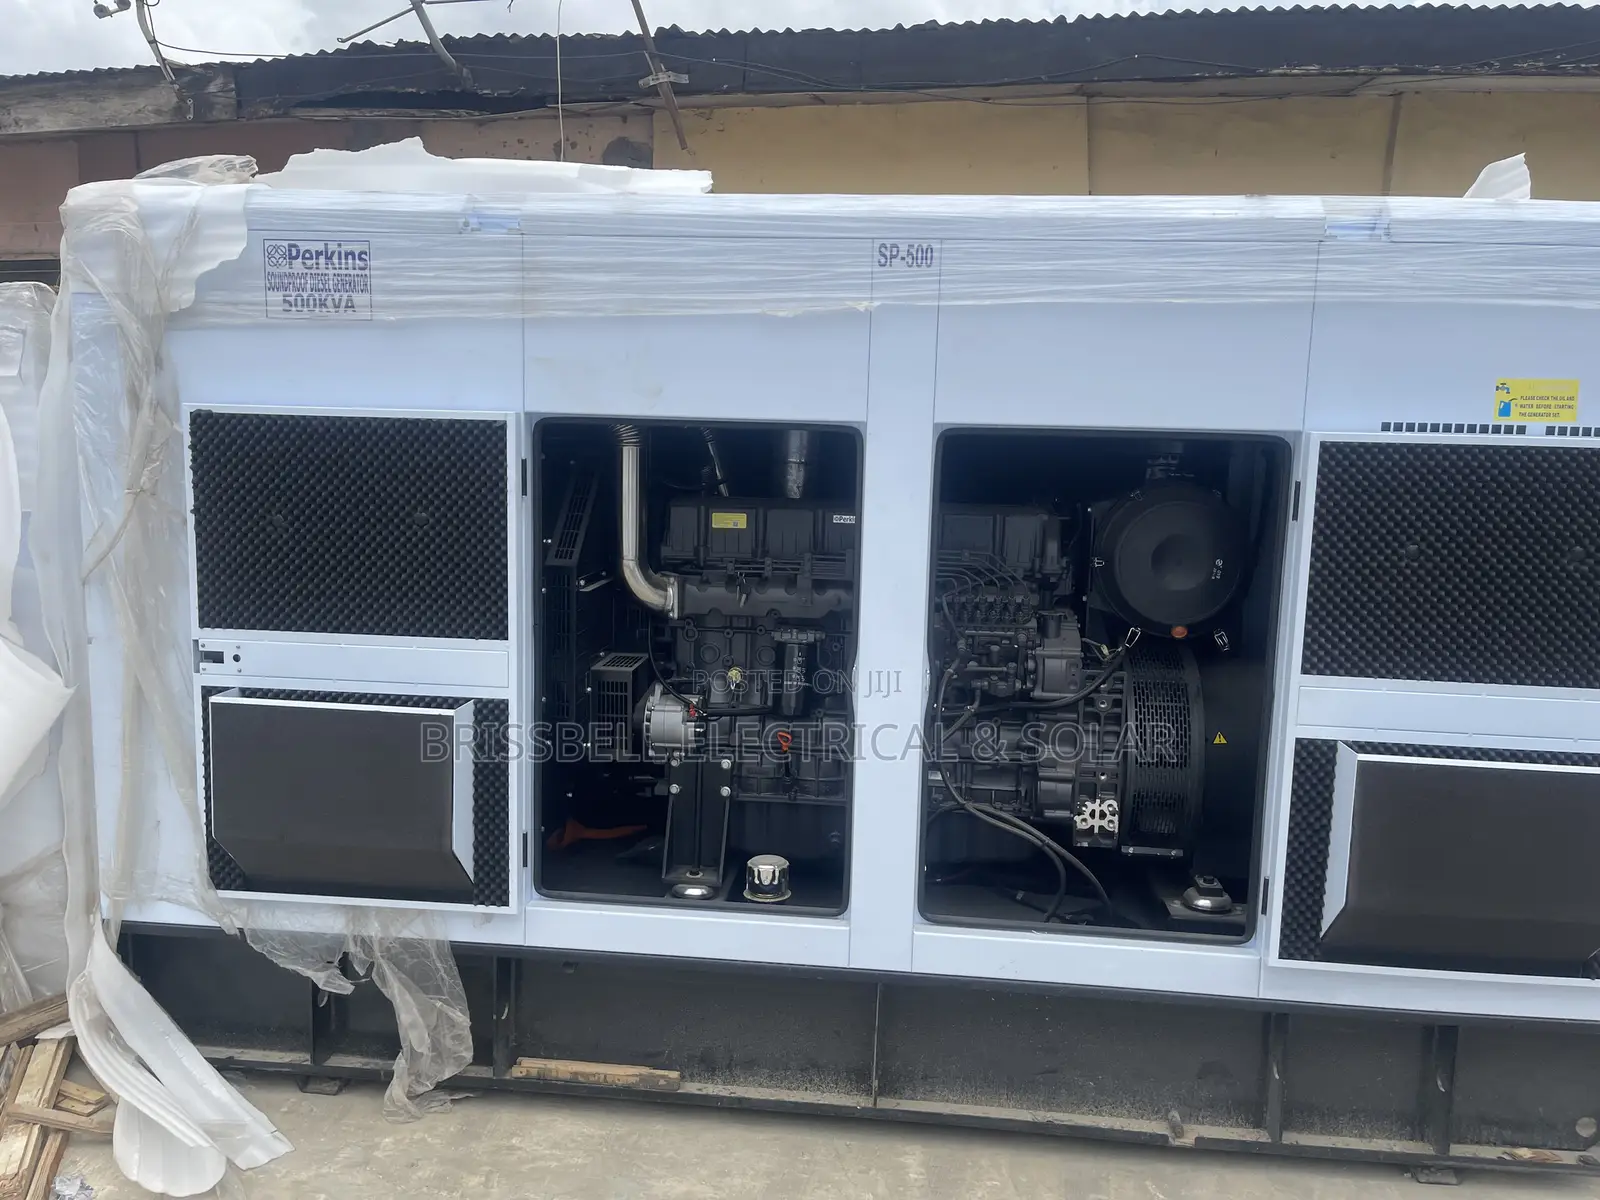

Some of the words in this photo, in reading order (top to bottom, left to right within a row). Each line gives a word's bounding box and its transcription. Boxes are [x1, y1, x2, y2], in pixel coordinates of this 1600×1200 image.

[288, 243, 369, 270] Perkins
[878, 243, 934, 268] SP-500
[267, 271, 308, 292] SOUNDPROOF
[310, 273, 331, 292] DIESEL
[333, 273, 369, 293] GENERATOR
[282, 293, 357, 313] 500KVA
